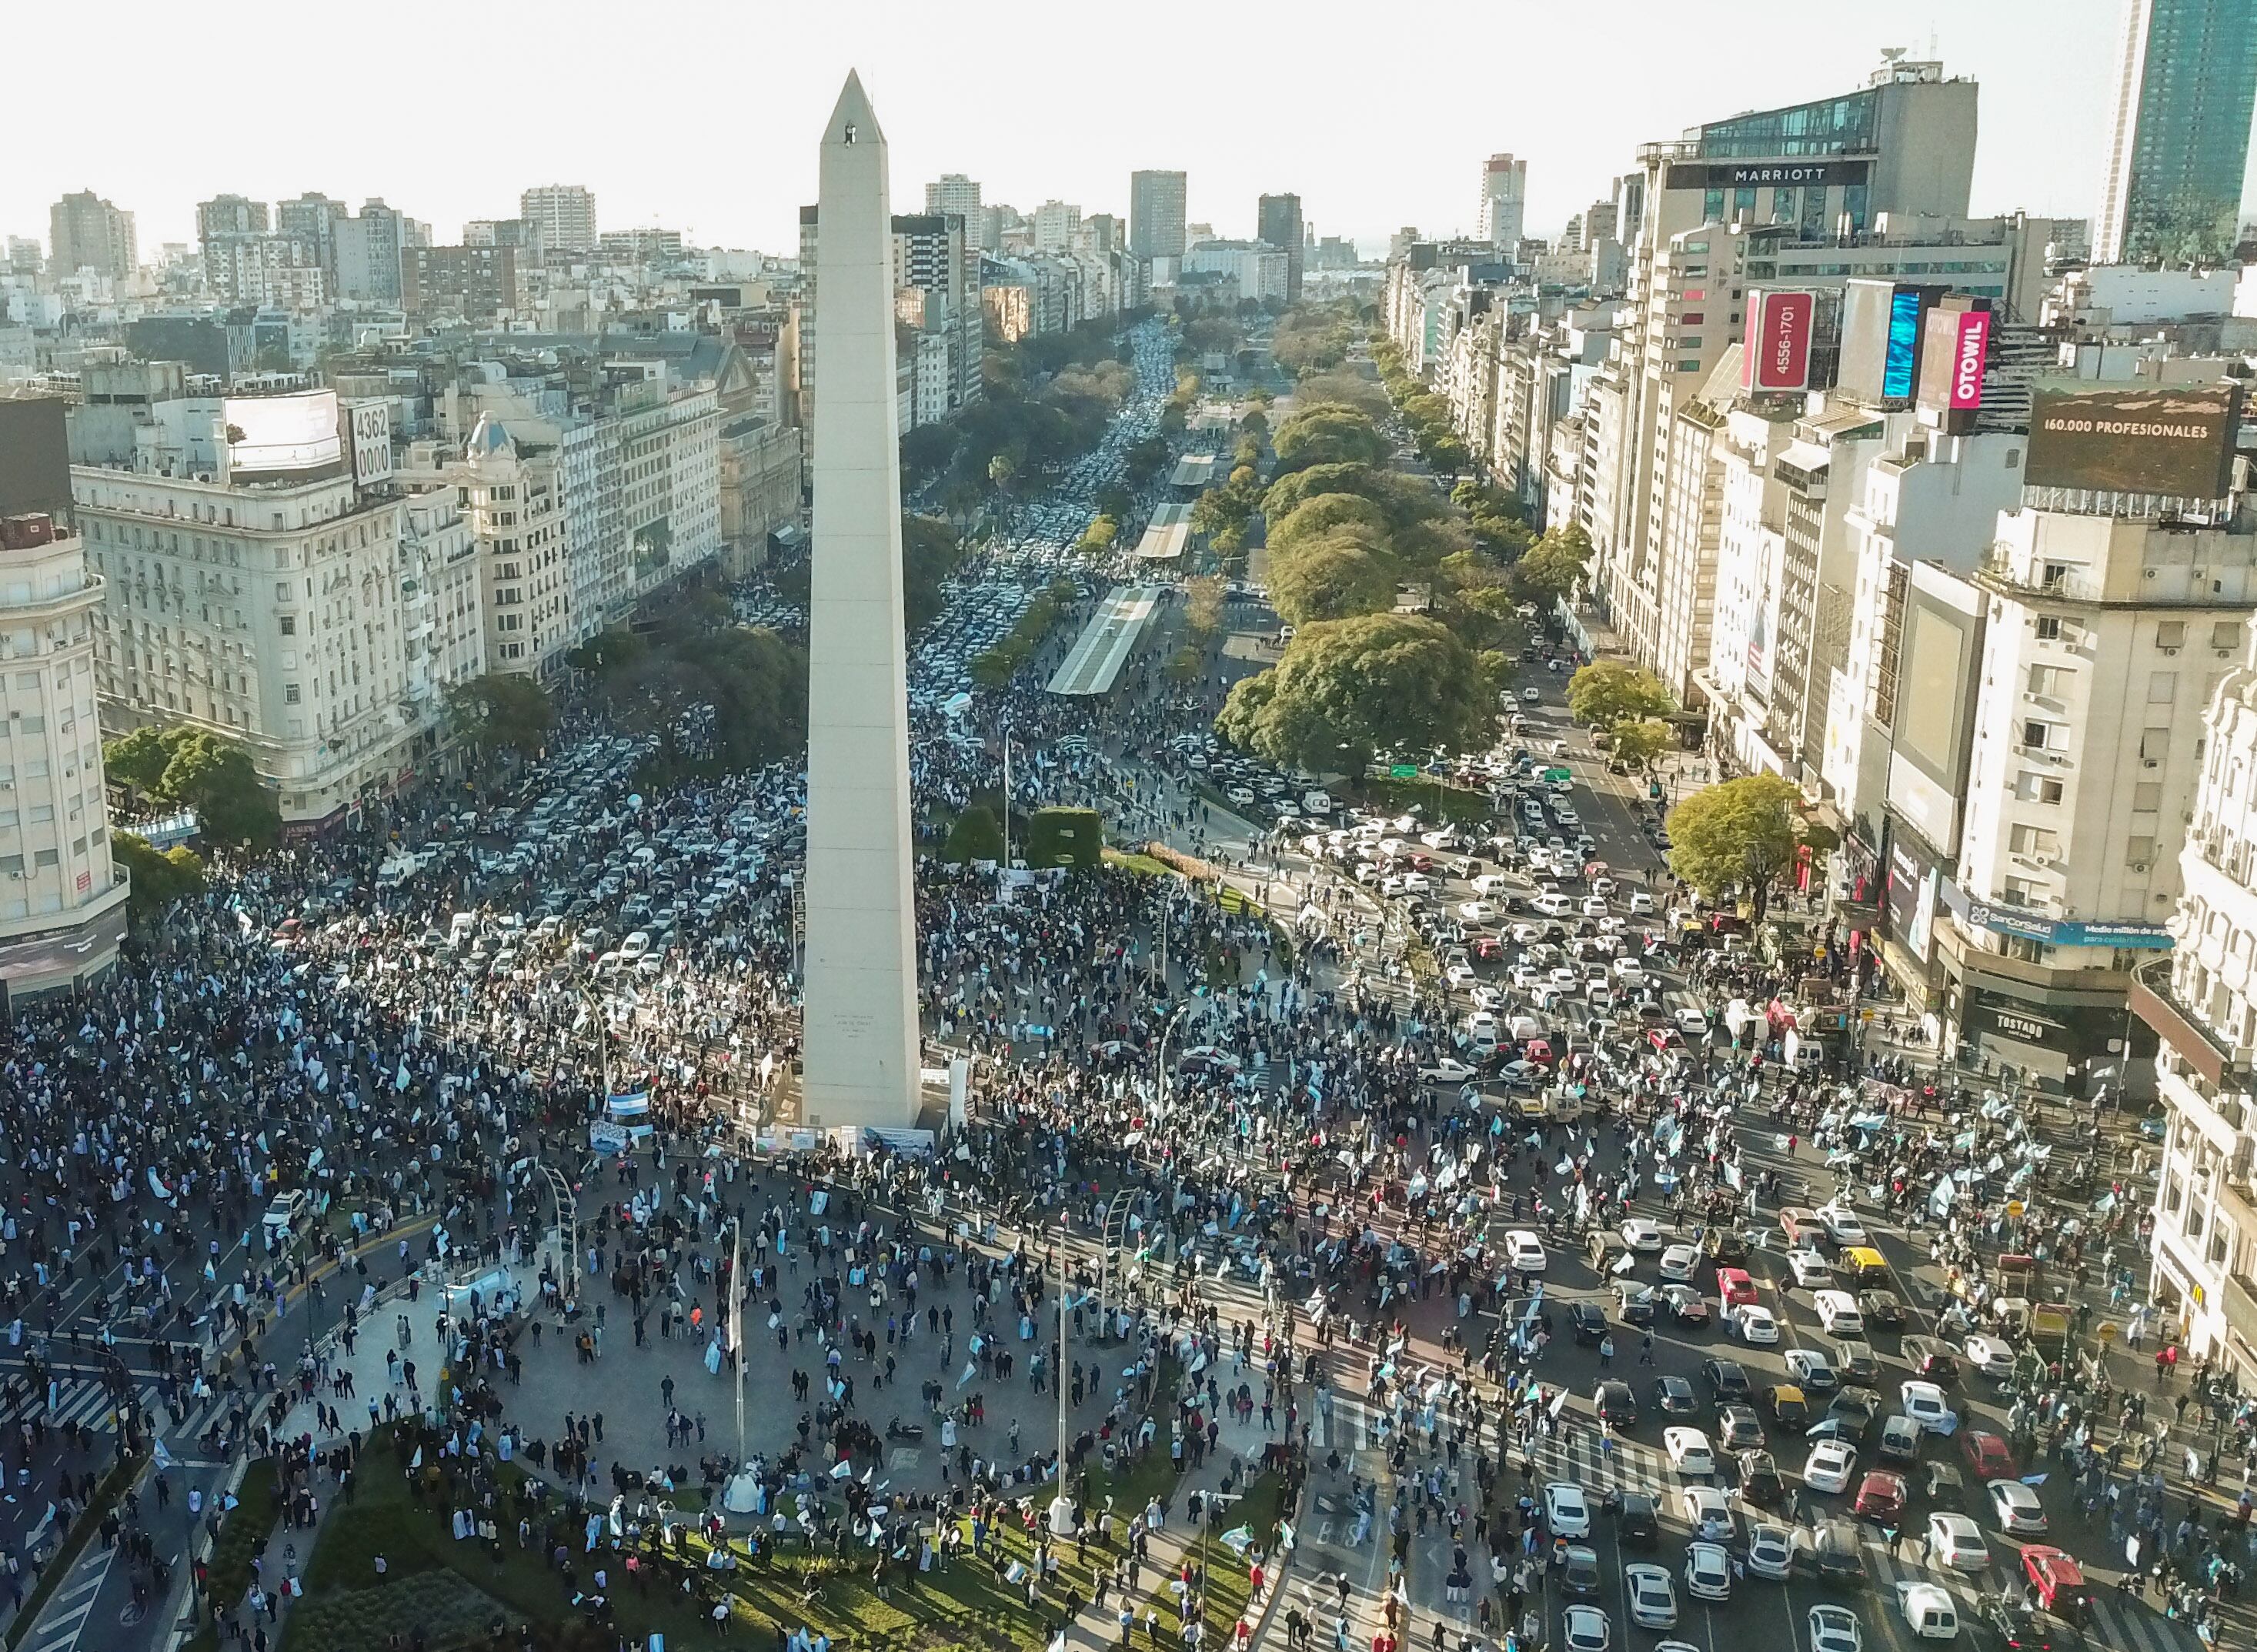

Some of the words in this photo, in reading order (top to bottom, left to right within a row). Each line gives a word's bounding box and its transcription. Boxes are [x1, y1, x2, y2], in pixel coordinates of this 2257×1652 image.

[1735, 169, 1825, 182] MARRIOTT
[1777, 306, 1795, 375] 4556-1701
[1957, 321, 1982, 400] OTOWIL
[357, 409, 386, 441] 4362
[2045, 419, 2092, 432] 160.000
[2095, 421, 2208, 439] PROFESIONALES
[359, 444, 388, 478] 0000
[2085, 925, 2112, 933] Medio
[2113, 926, 2139, 935] millón
[1997, 1015, 2043, 1038] TOSTADO
